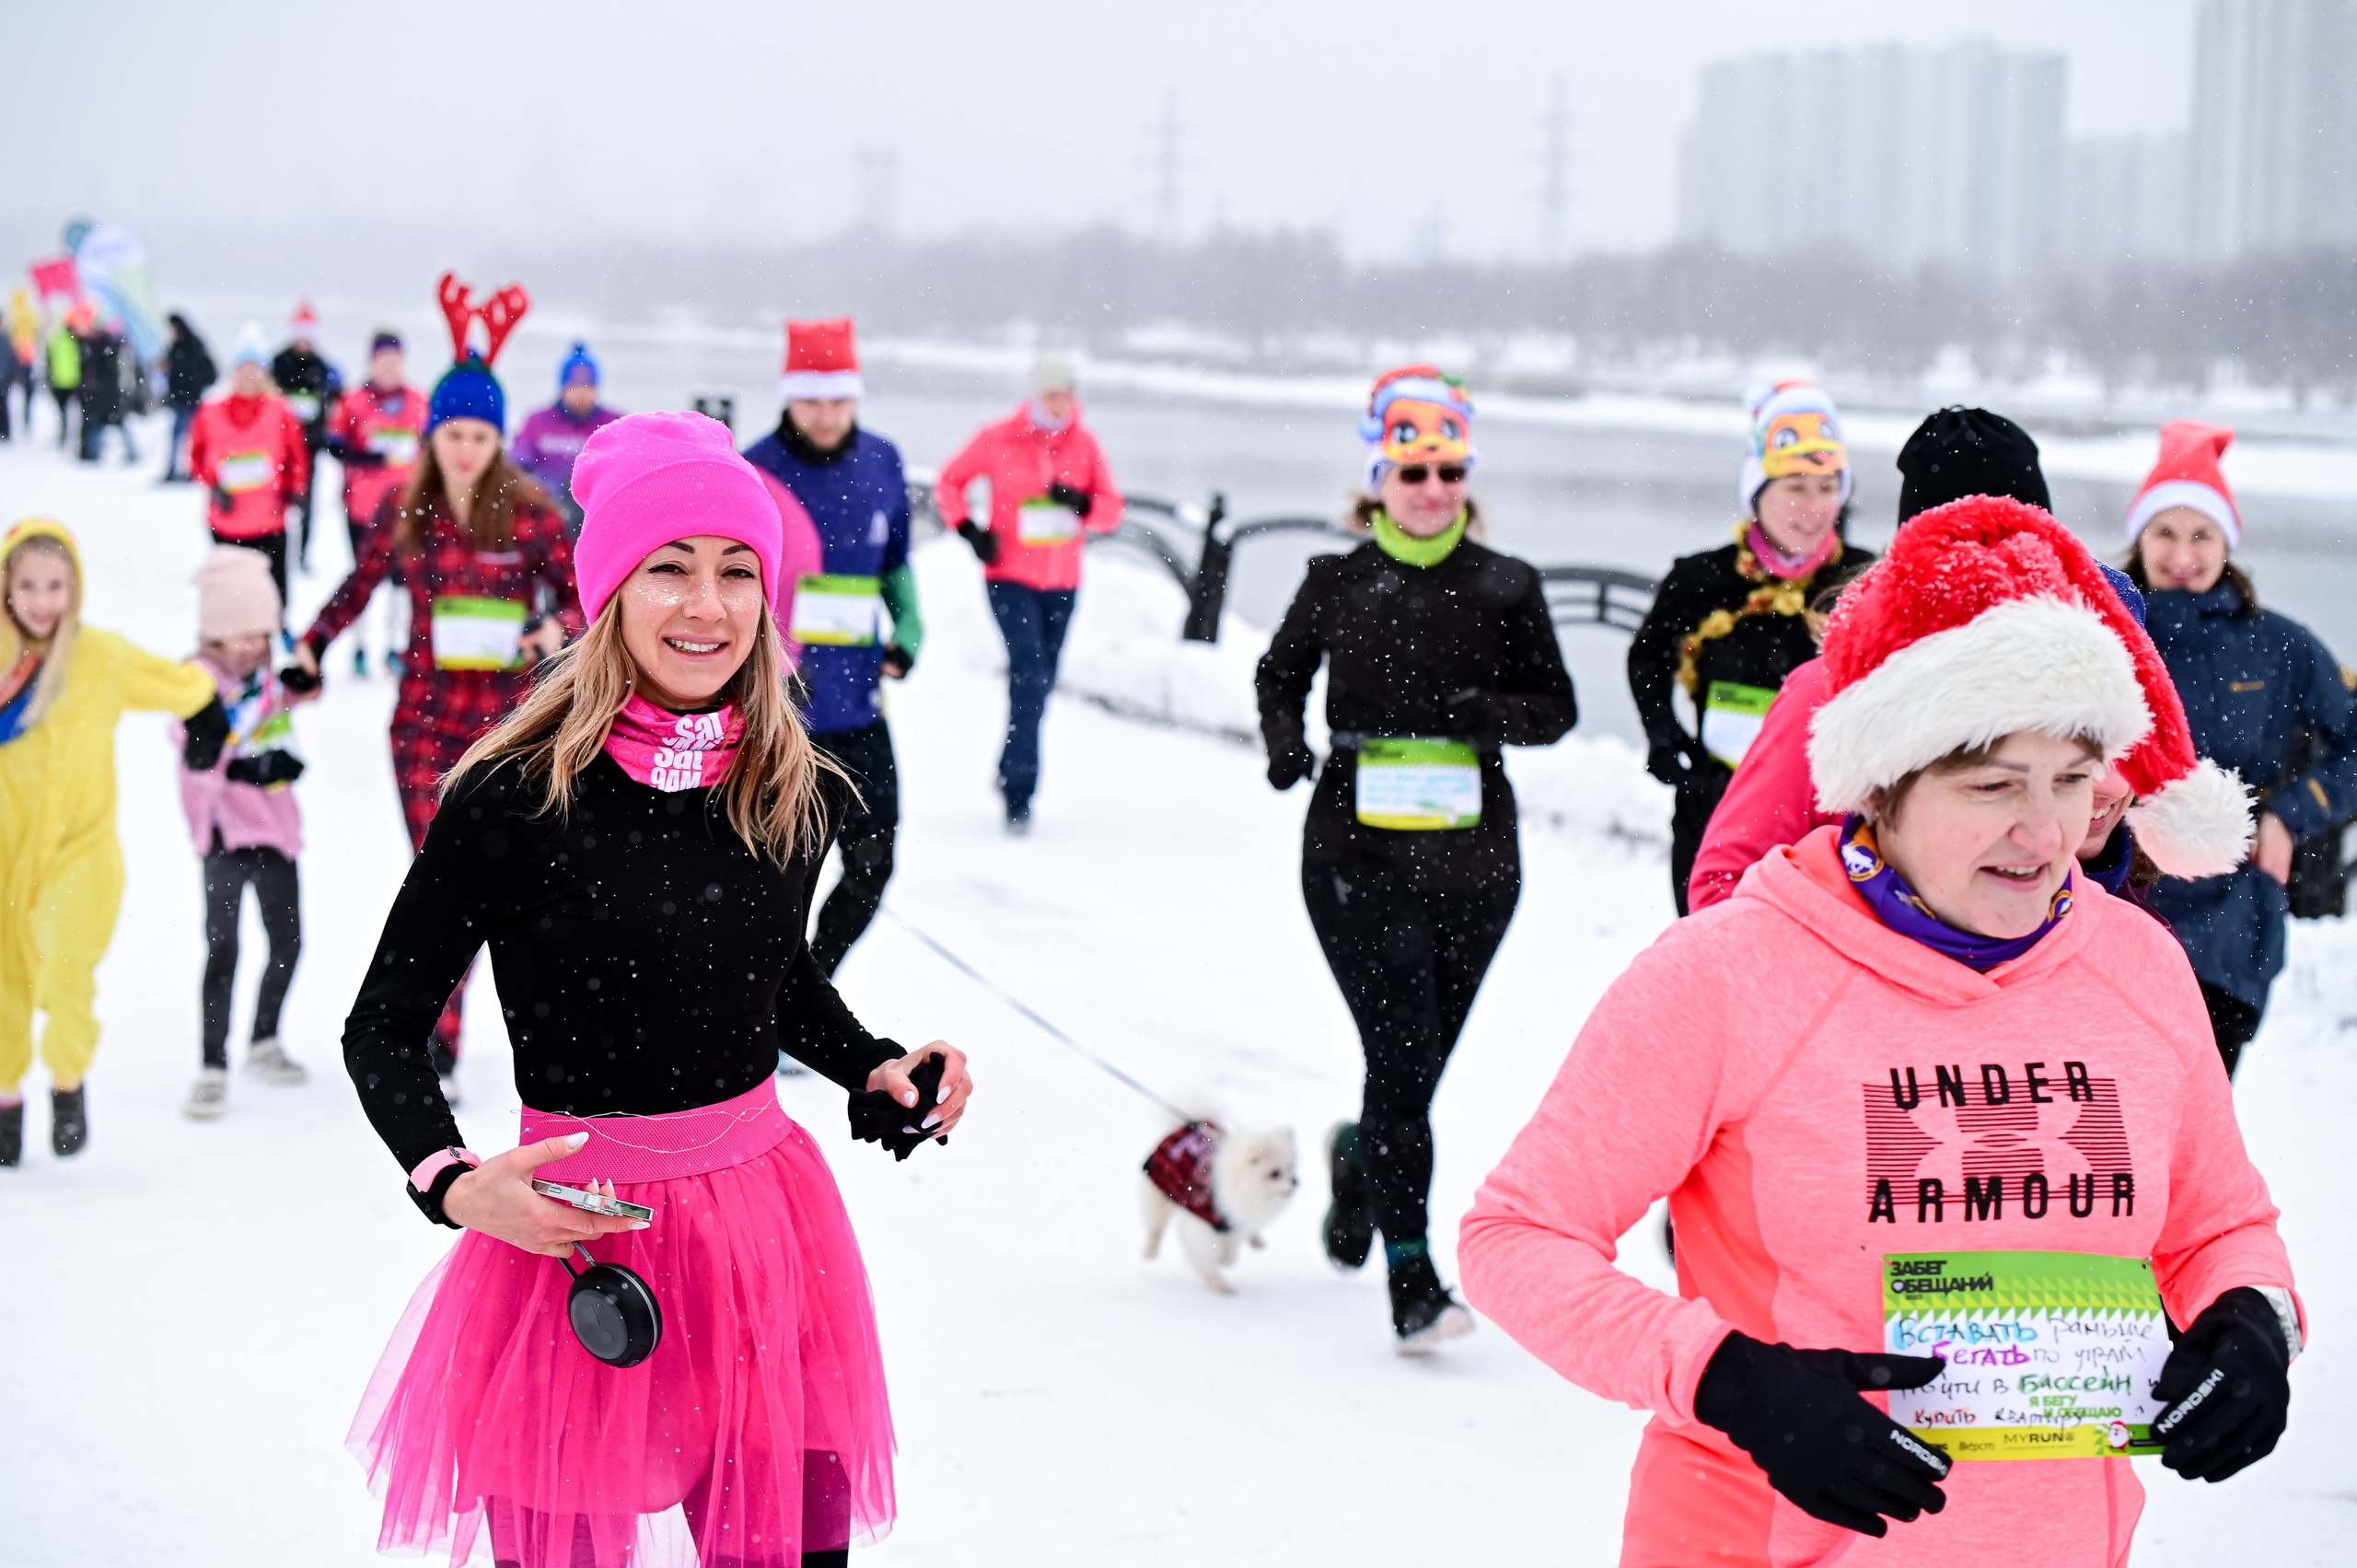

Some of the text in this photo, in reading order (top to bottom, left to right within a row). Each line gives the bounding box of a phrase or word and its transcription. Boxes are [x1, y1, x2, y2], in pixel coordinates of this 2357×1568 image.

[1889, 1061, 2094, 1110] UNDER
[1868, 1173, 2134, 1223] ARMOUR
[1890, 1260, 1947, 1276] ЗАБЕГ
[1891, 1271, 1993, 1296] ОБЕЩАНИЙ
[2029, 1395, 2078, 1407] Я БЕГУ
[2057, 1406, 2123, 1419] ОБЕЩАЮ
[2156, 1367, 2225, 1434] NORDSKI
